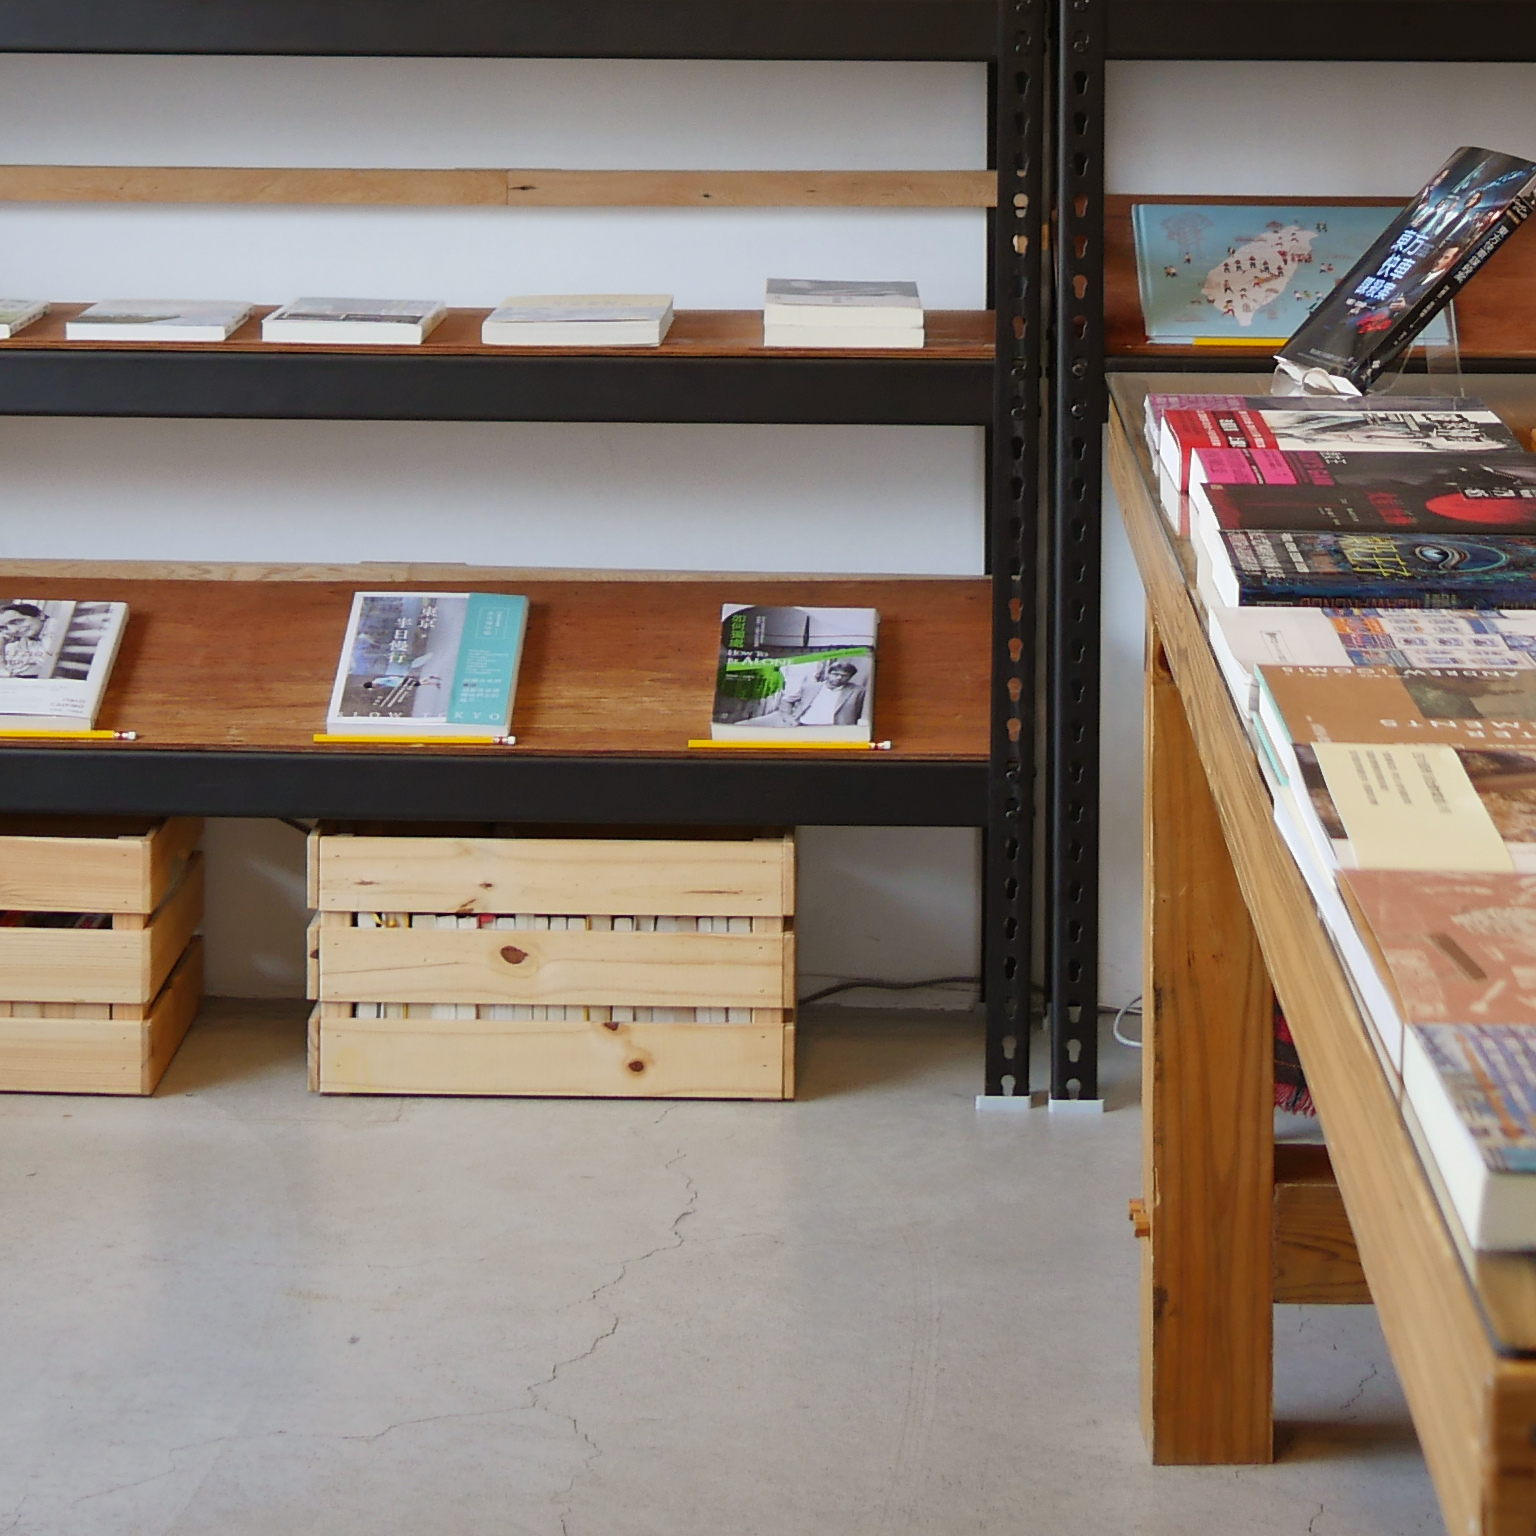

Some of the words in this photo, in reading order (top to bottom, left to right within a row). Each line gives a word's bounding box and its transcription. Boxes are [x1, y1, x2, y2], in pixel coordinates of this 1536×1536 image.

[388, 620, 413, 668] 半日慢行
[742, 657, 795, 666] ALONE
[1281, 666, 1388, 677] LOOMIS
[1404, 668, 1519, 678] ANDREW
